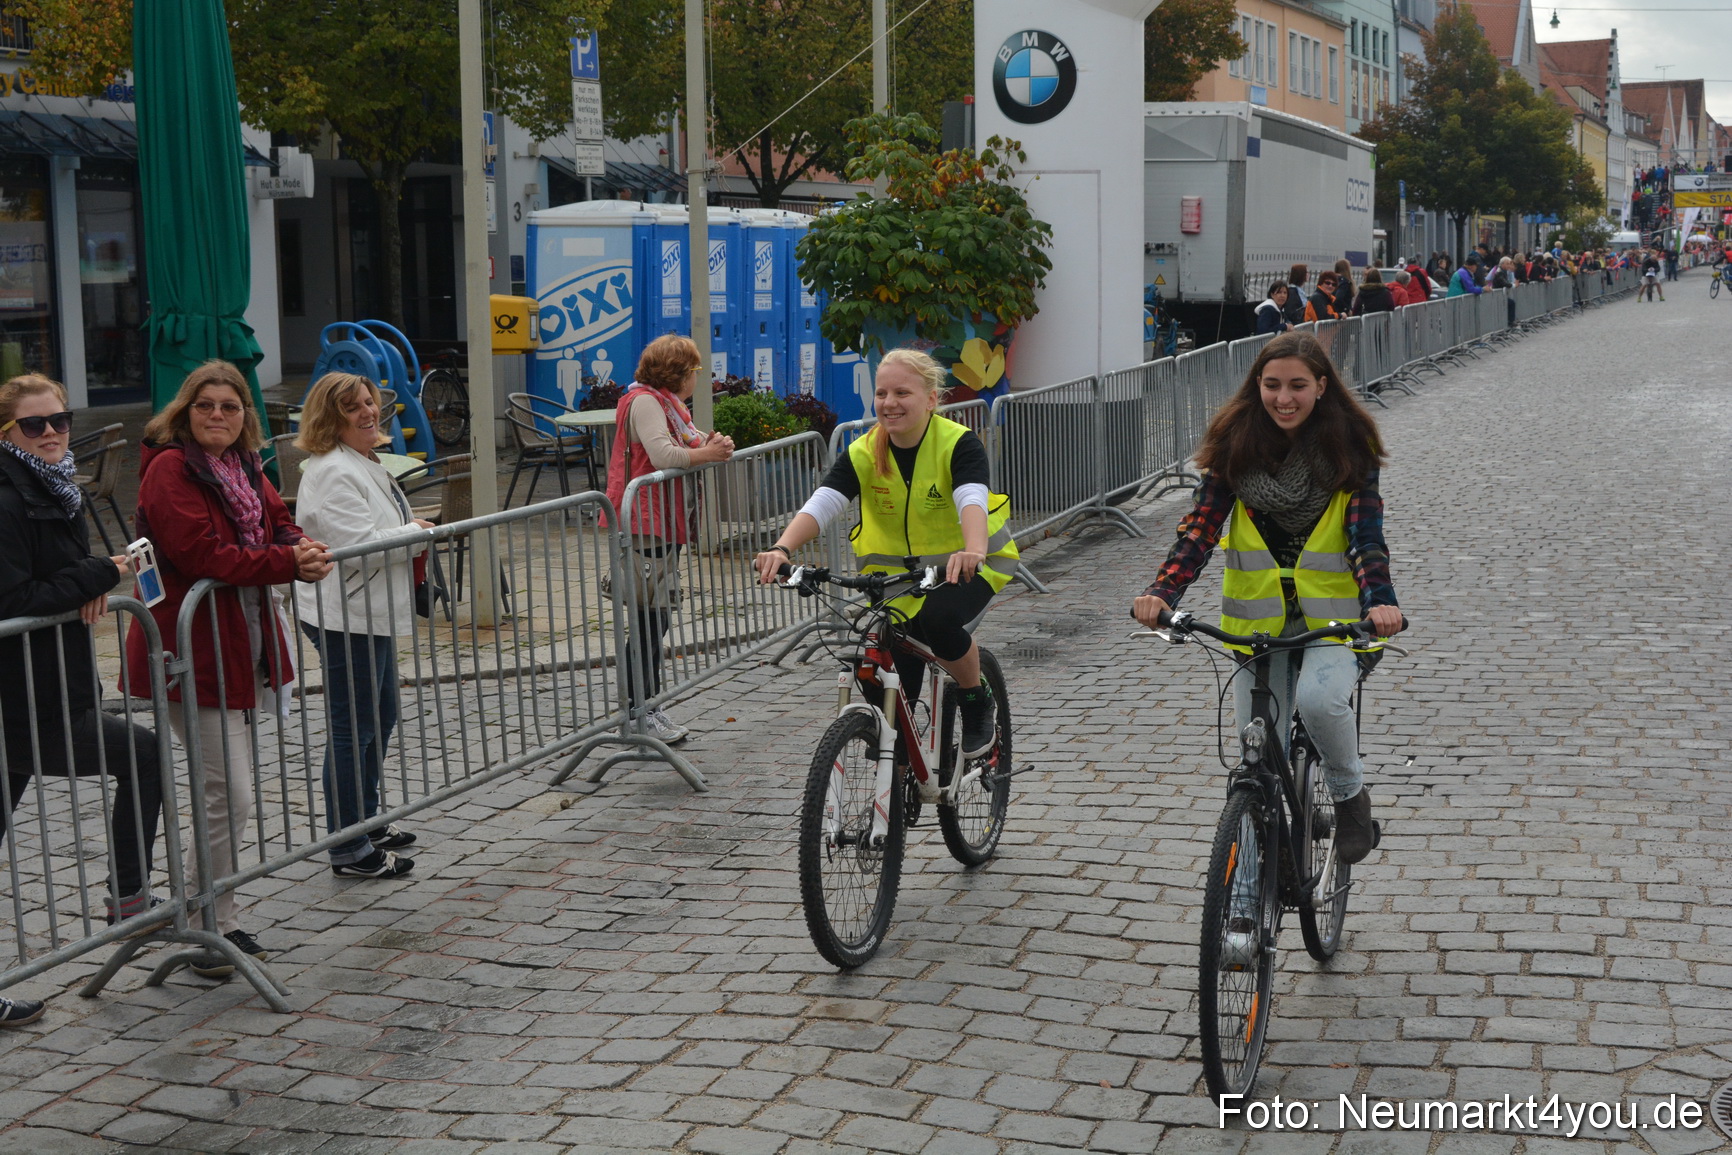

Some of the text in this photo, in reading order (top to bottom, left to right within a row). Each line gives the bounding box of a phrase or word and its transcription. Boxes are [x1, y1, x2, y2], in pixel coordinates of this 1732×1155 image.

[998, 32, 1069, 63] BMW
[575, 94, 599, 104] Parkschein
[578, 105, 599, 116] werktags
[260, 178, 301, 189] Hut & Mode
[513, 201, 522, 222] 3
